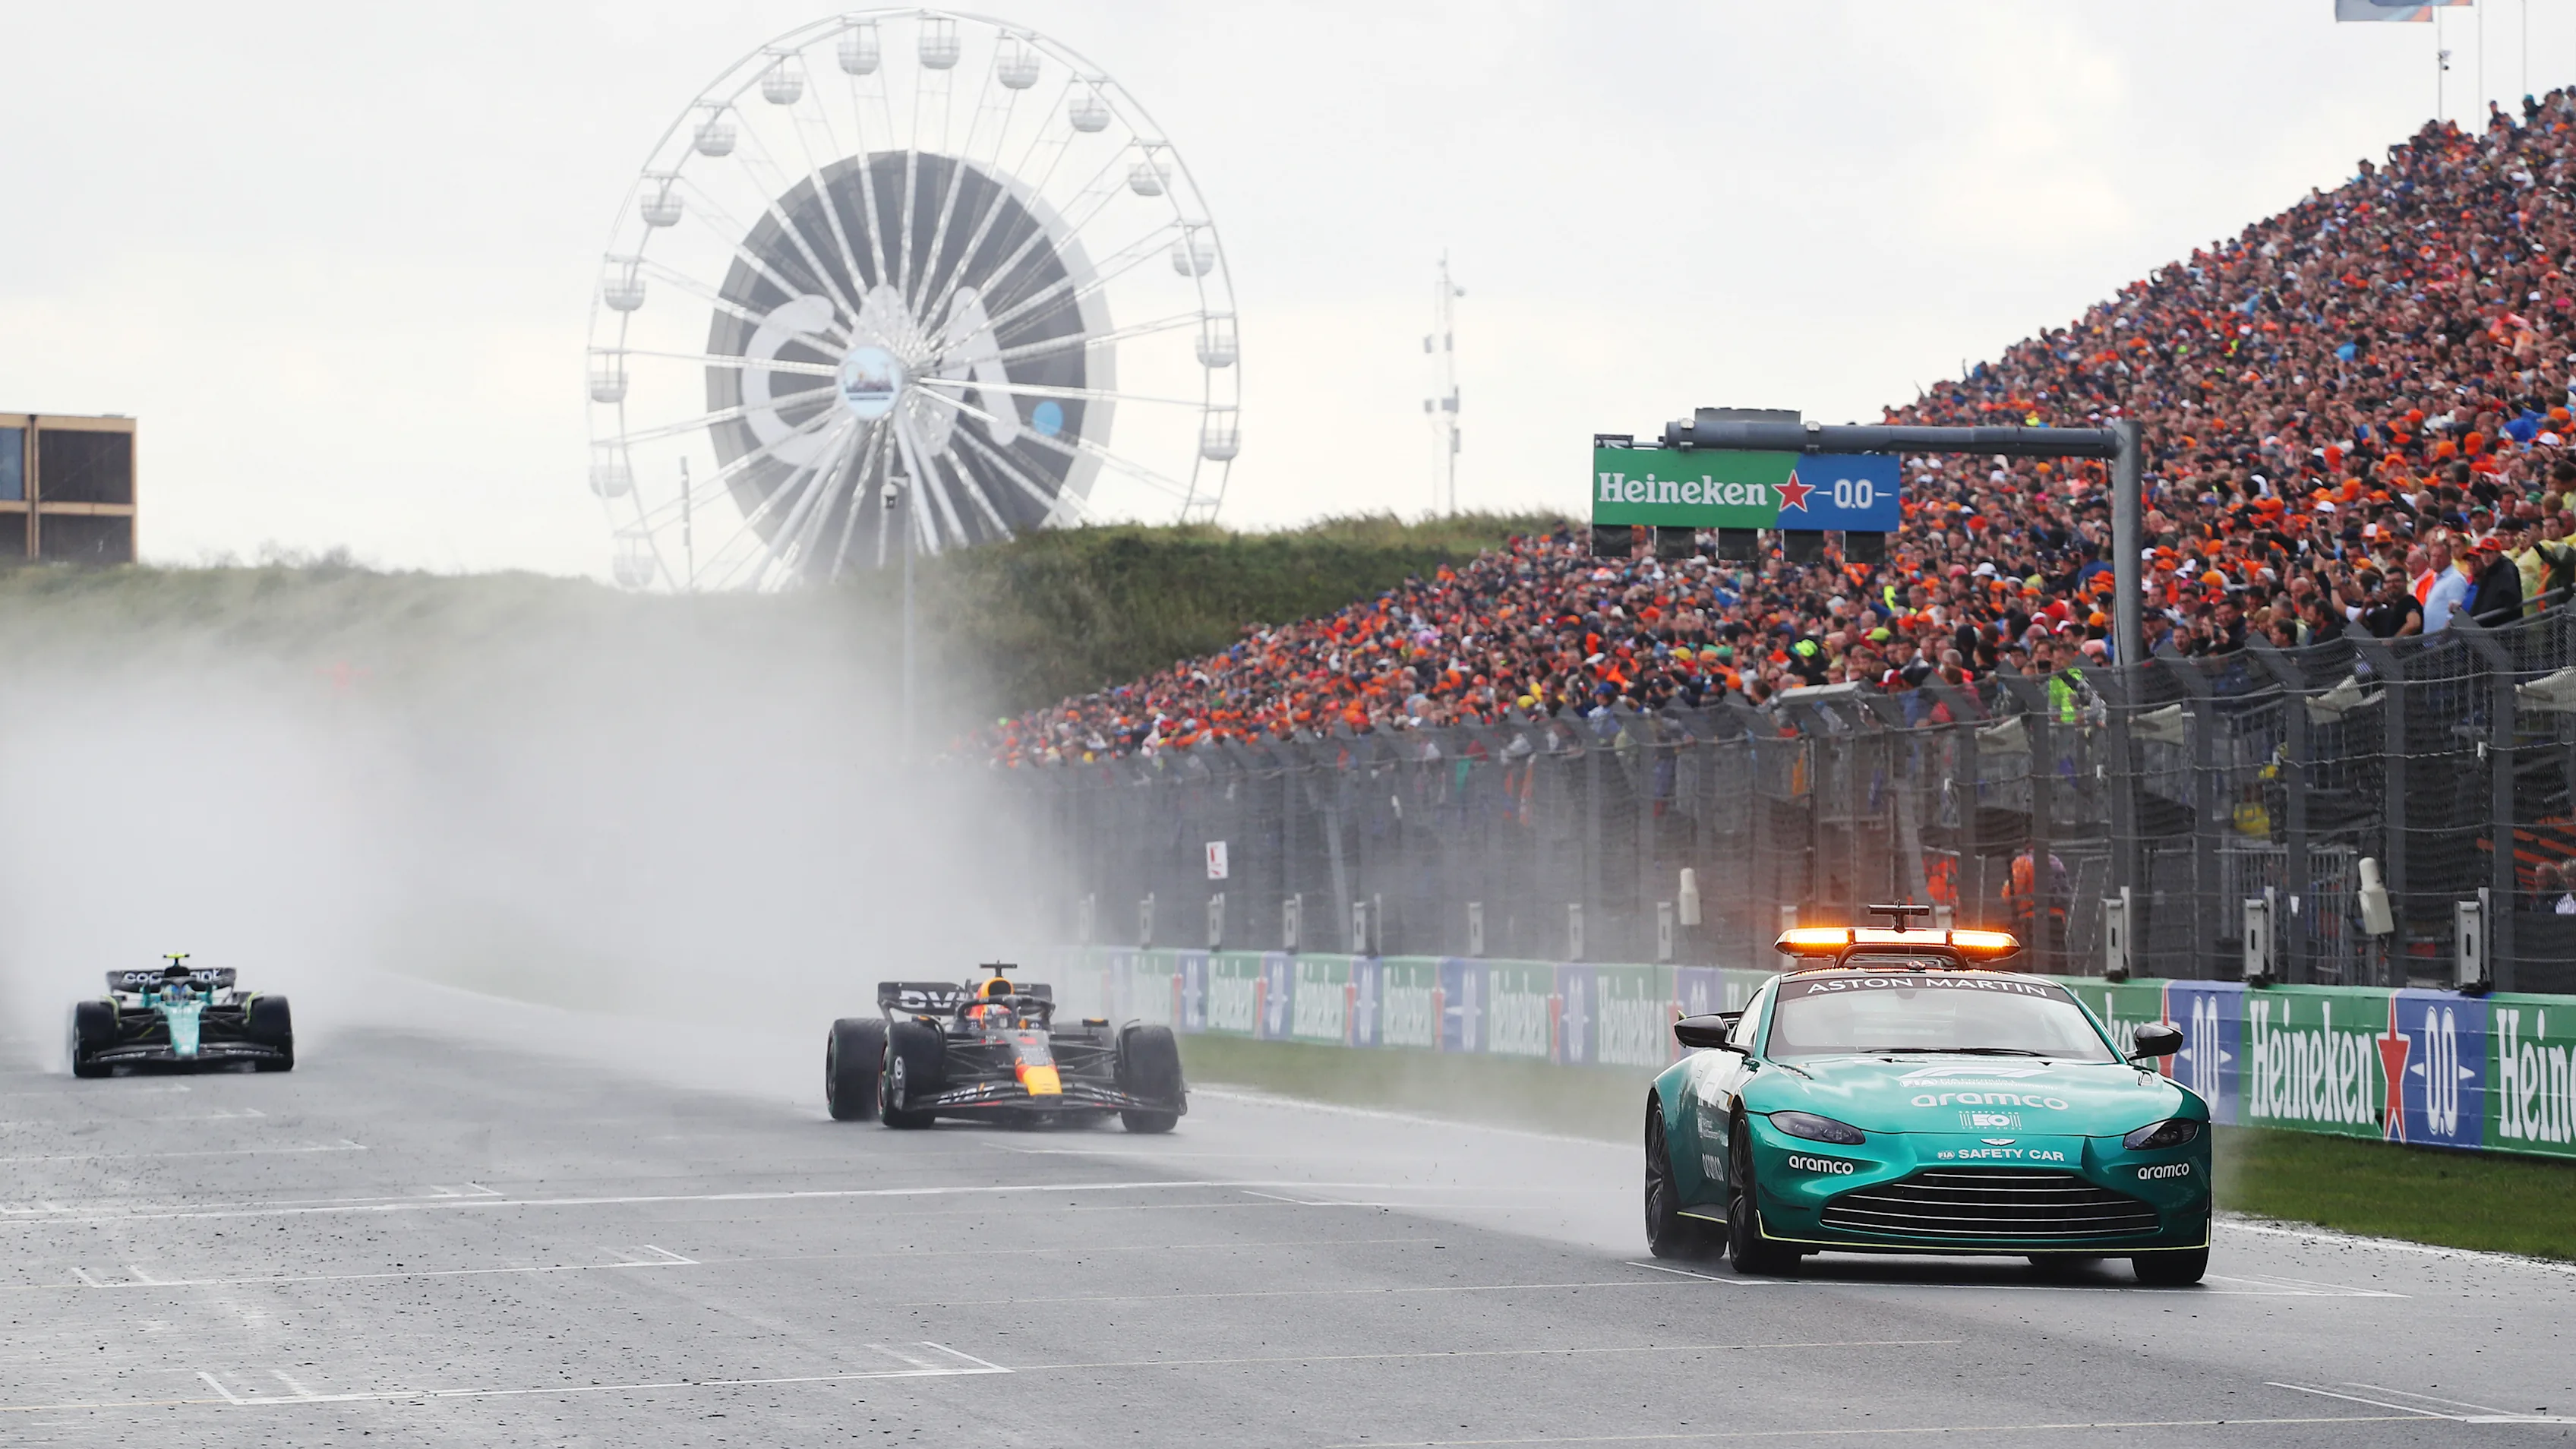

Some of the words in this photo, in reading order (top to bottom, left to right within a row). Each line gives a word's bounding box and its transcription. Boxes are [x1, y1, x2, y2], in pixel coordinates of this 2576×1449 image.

[1598, 472, 1768, 506] Heineken
[1833, 478, 1874, 510] 0.0
[1807, 977, 1913, 994] ASTON
[1925, 977, 2047, 997] MARTIN
[1597, 975, 1666, 1067] Heineken
[2249, 999, 2376, 1125] Heineken
[1911, 1092, 2069, 1110] aramco
[1788, 1155, 1855, 1175] aramco
[1938, 1151, 1955, 1160] FIA
[1958, 1148, 2023, 1160] SAFETY
[2028, 1149, 2065, 1162] CAR
[2137, 1163, 2190, 1180] aramco
